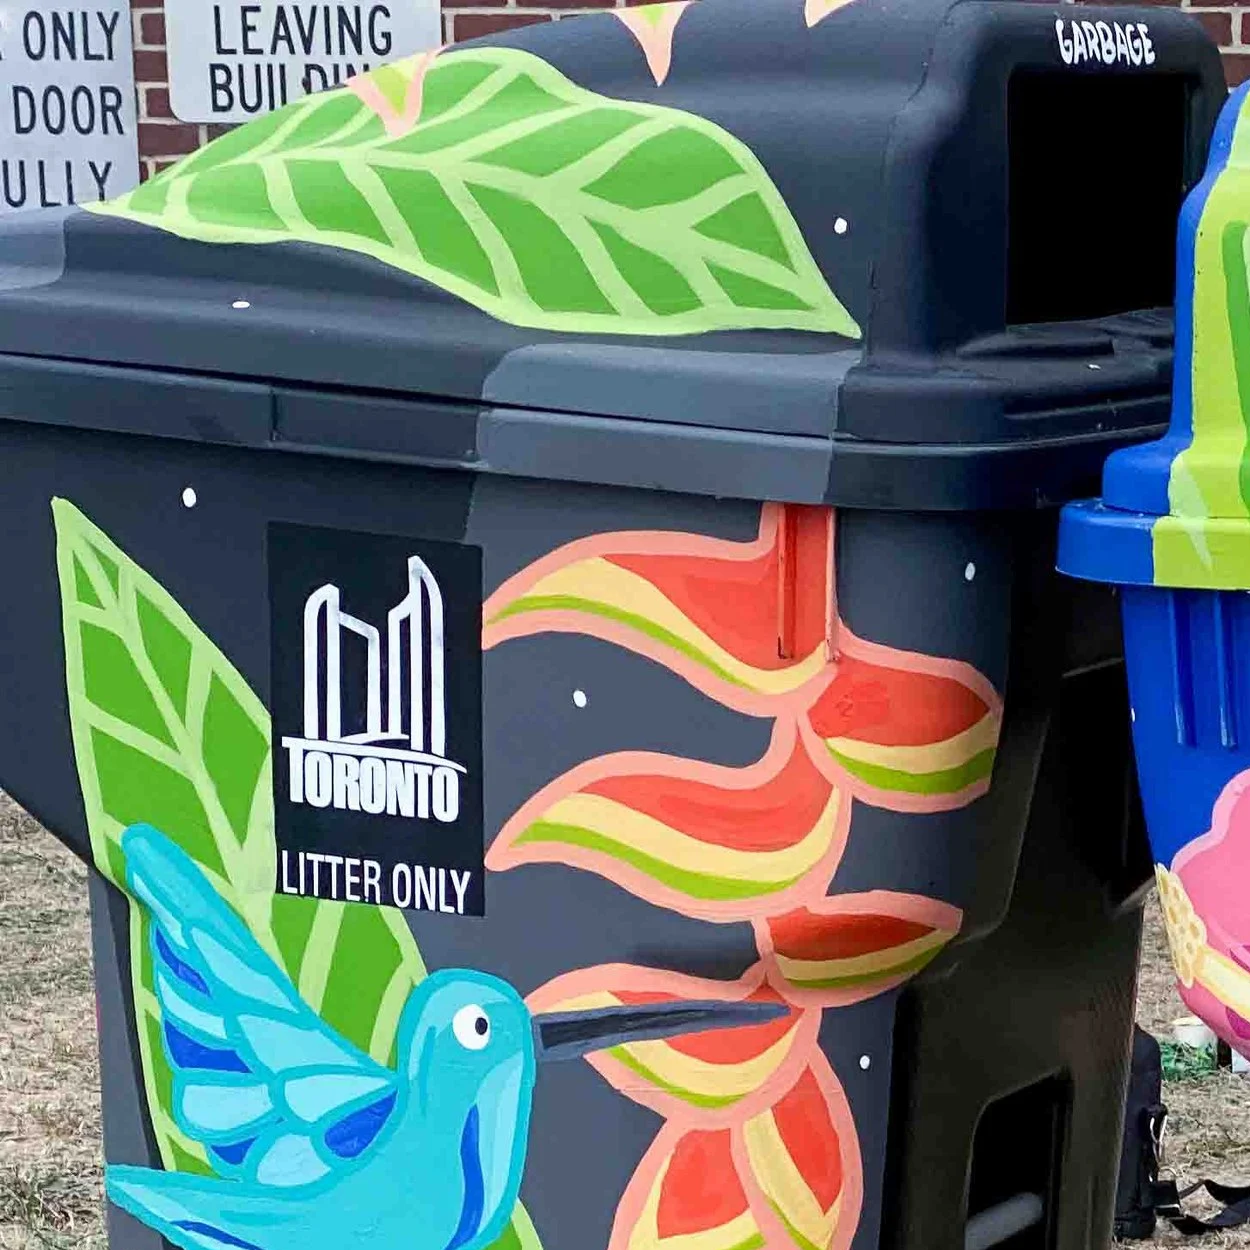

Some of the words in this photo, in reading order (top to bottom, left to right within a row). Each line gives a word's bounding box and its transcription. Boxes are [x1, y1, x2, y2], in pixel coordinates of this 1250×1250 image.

[23, 11, 119, 61] ONLY
[215, 5, 392, 55] LEAVING
[1055, 20, 1155, 66] GARBAGE
[12, 85, 124, 135] DOOR
[282, 738, 462, 823] TORONTO
[281, 850, 381, 904] LITTER
[392, 862, 471, 914] ONLY
